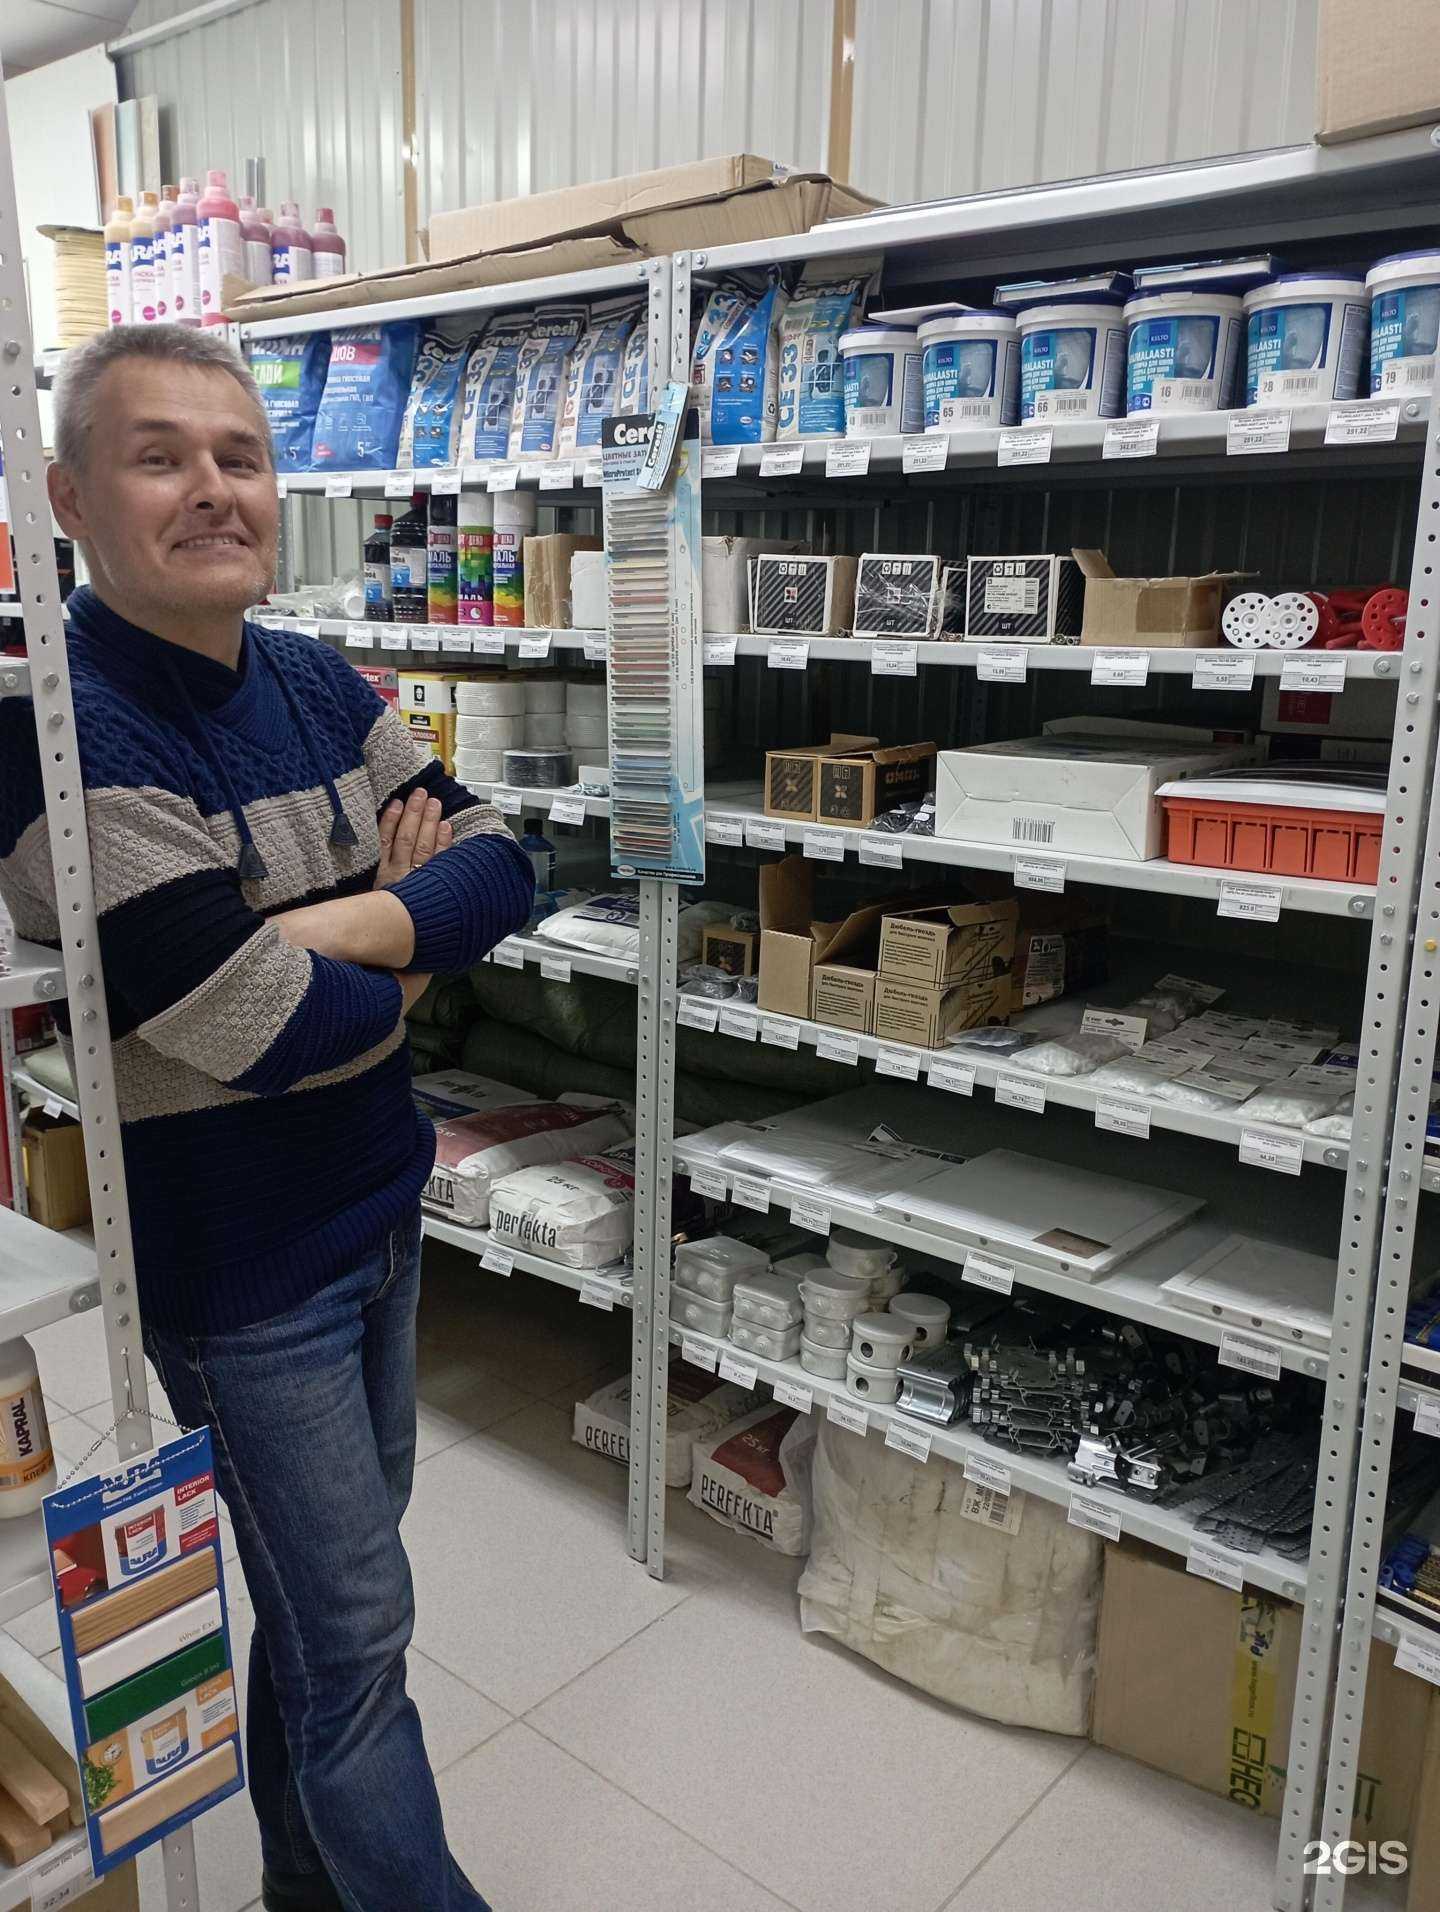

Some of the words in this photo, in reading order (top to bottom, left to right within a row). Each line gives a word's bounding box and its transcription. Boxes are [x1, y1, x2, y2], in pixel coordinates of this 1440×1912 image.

[780, 343, 799, 384] 33
[1160, 386, 1172, 398] 16
[943, 406, 954, 418] 65
[1037, 401, 1048, 413] 66
[1001, 622, 1012, 630] ШТ
[495, 1207, 558, 1248] perfekta
[11, 1397, 33, 1457] KAPRAL
[176, 1474, 210, 1496] INTERIOR
[177, 1489, 197, 1501] LACK
[701, 1473, 774, 1534] PERFEKTA
